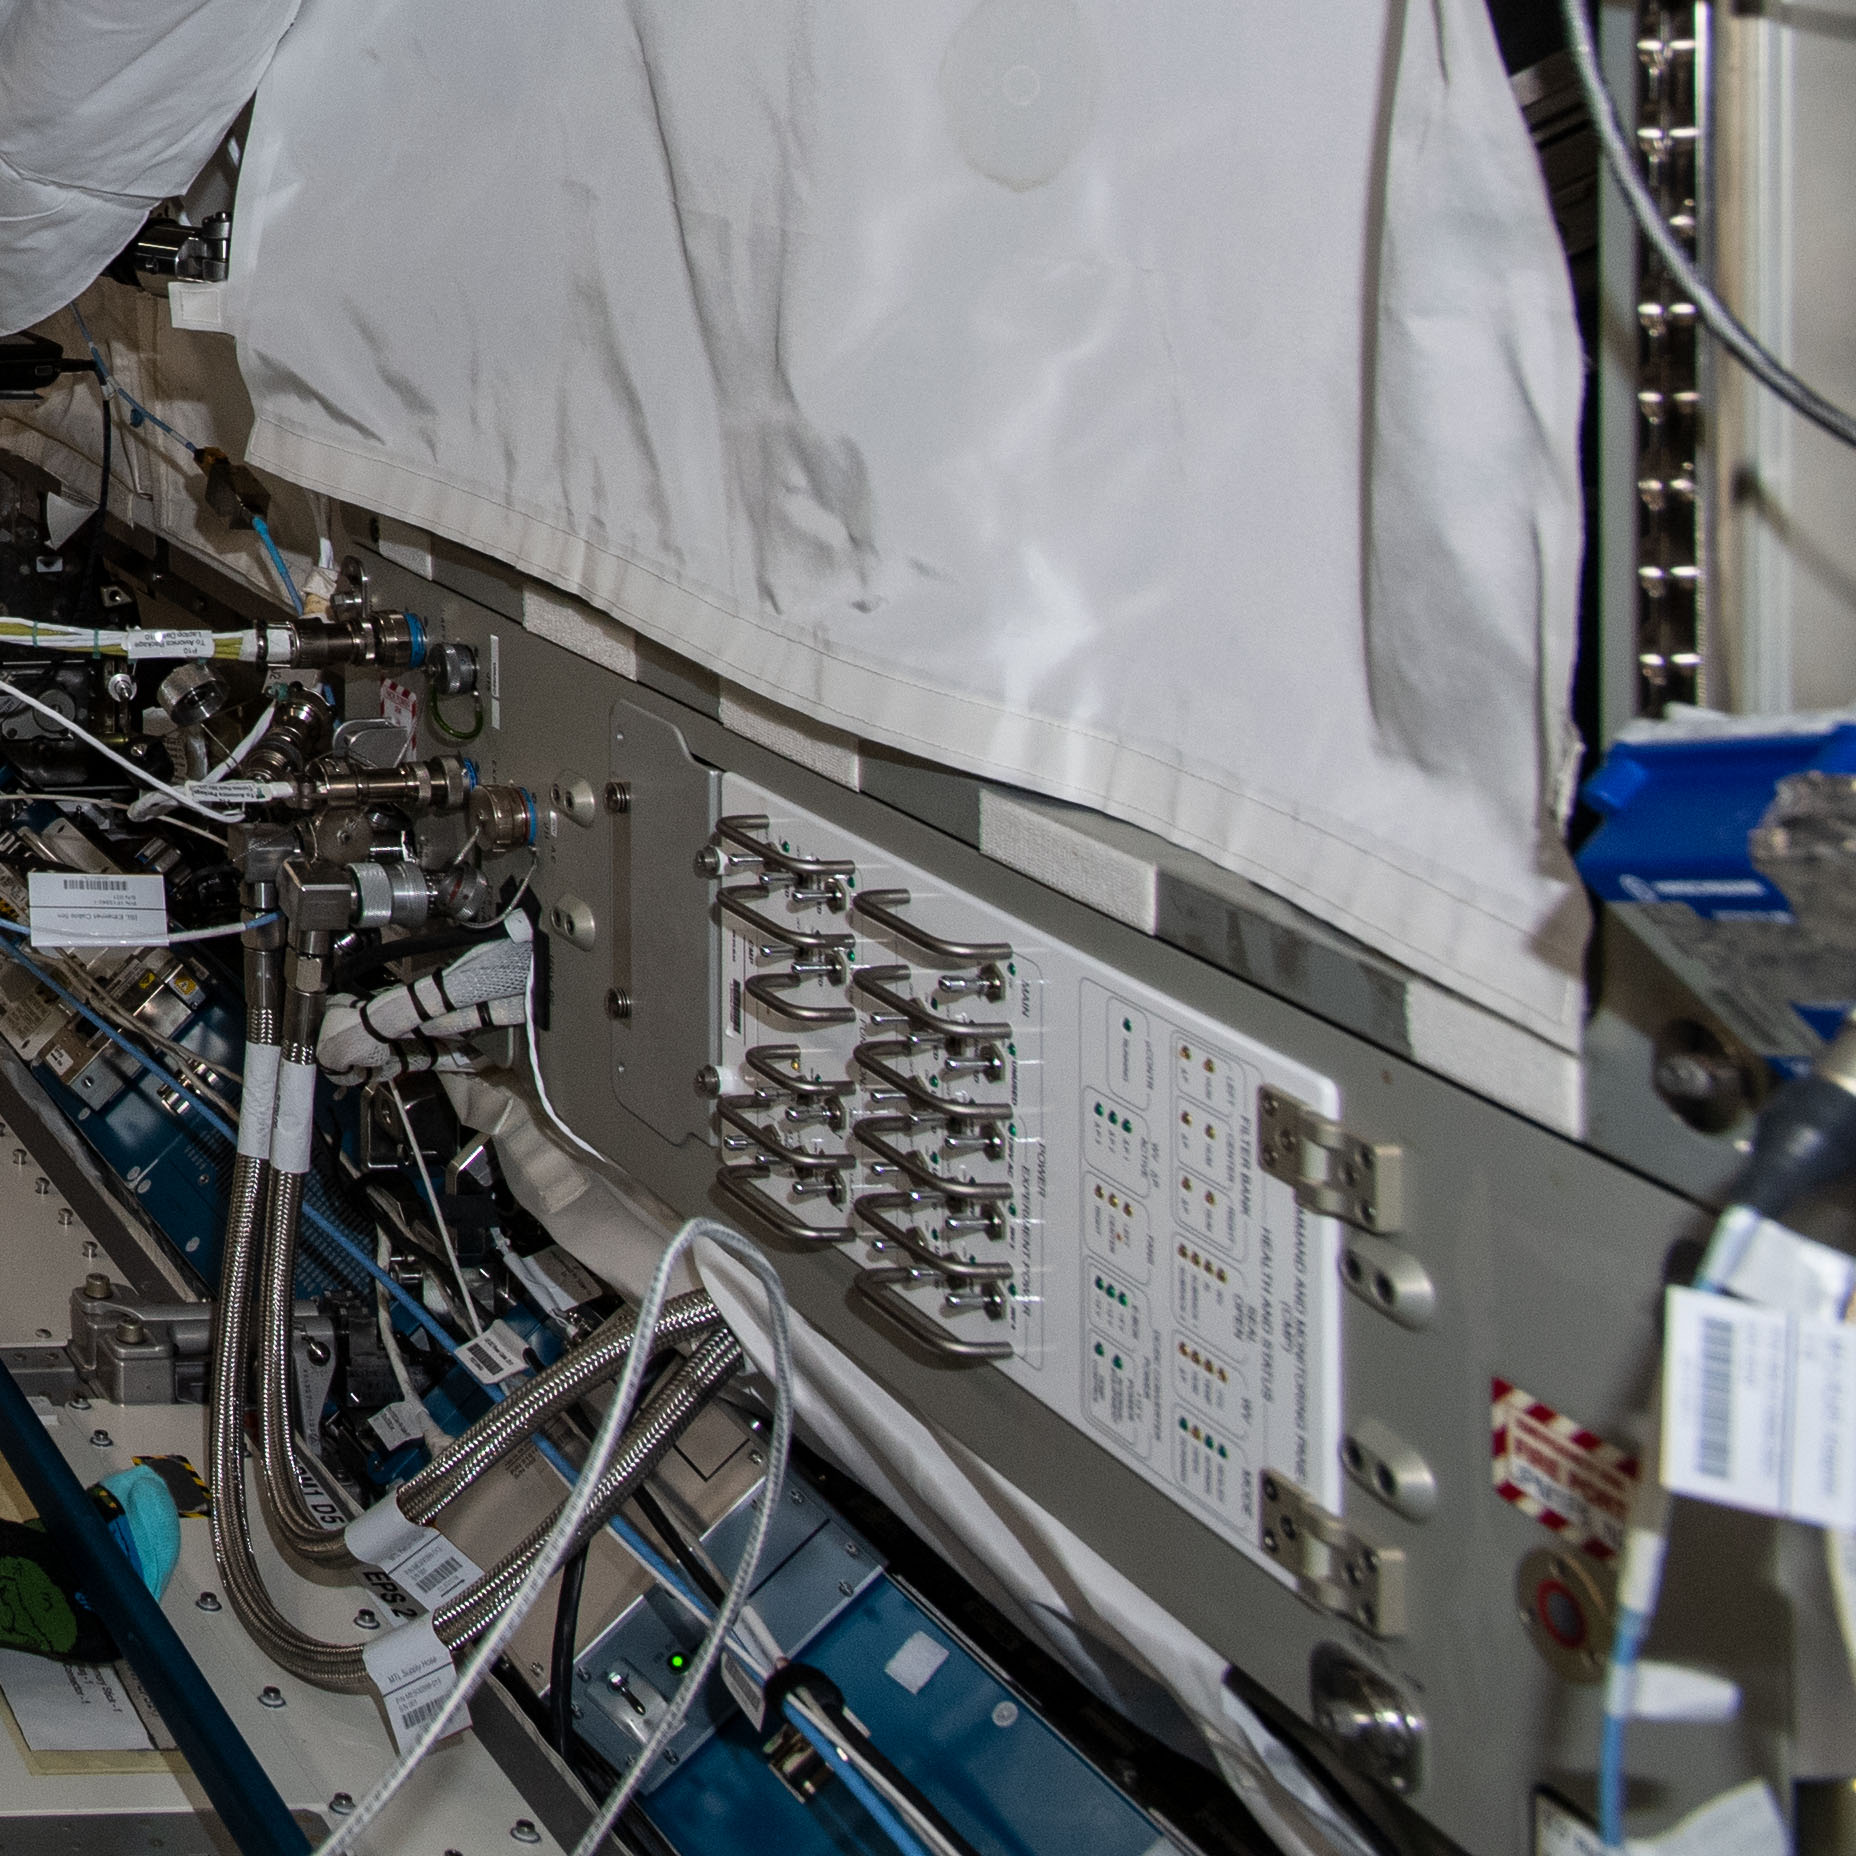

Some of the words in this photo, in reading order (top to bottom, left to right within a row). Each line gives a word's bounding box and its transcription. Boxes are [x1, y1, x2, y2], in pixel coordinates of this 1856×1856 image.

[133, 639, 165, 647] Package
[167, 638, 193, 646] Avionics
[93, 912, 123, 920] Ethernet
[1021, 980, 1031, 1018] MAIN
[1010, 1059, 1019, 1106] UNUSED
[1140, 1136, 1149, 1179] ACTIVE
[1226, 1132, 1236, 1185] CENTER
[1240, 1114, 1252, 1170] FILTER
[1037, 1142, 1047, 1198] POWER
[1022, 1164, 1031, 1260] EXPERIMENT
[1240, 1172, 1252, 1217] BANK
[1227, 1205, 1237, 1245] RIGHT
[1259, 1226, 1274, 1294] HEALTH
[1022, 1261, 1031, 1317] POWER
[1233, 1293, 1245, 1342] OPEN
[1260, 1297, 1274, 1335] AND
[1260, 1337, 1274, 1403] STATUS
[310, 1494, 344, 1532] D5
[362, 1561, 406, 1612] EPS
[390, 1598, 419, 1626] 2
[63, 1661, 83, 1698] Connector
[400, 1664, 423, 1678] Supply
[421, 1656, 437, 1667] Hose
[102, 1686, 115, 1705] Stick
